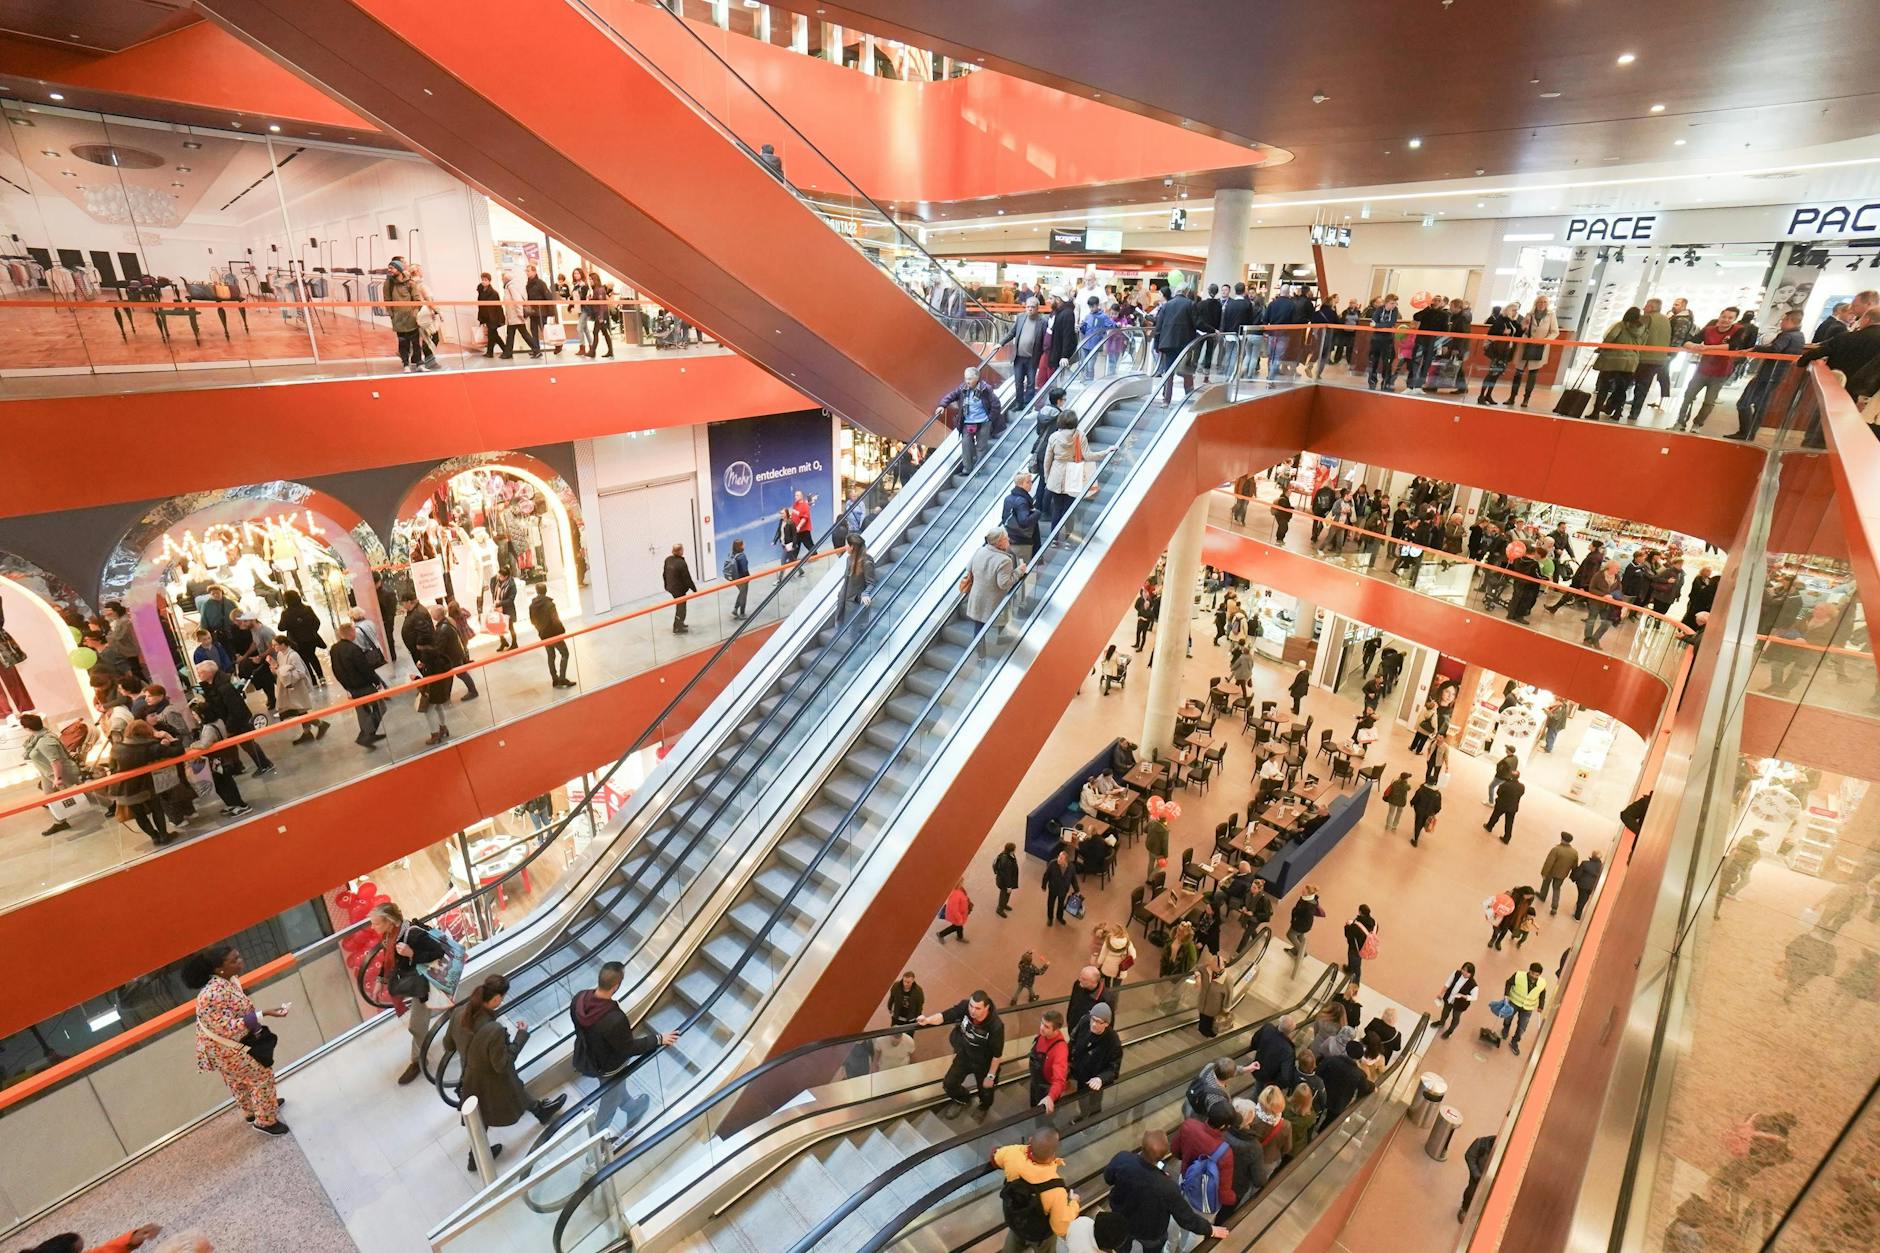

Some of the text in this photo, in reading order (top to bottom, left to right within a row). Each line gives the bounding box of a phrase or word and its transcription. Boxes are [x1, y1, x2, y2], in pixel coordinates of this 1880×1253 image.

[1566, 216, 1657, 241] PACE
[725, 464, 750, 488] Mehr
[756, 466, 797, 482] entdecken
[798, 462, 812, 473] mit
